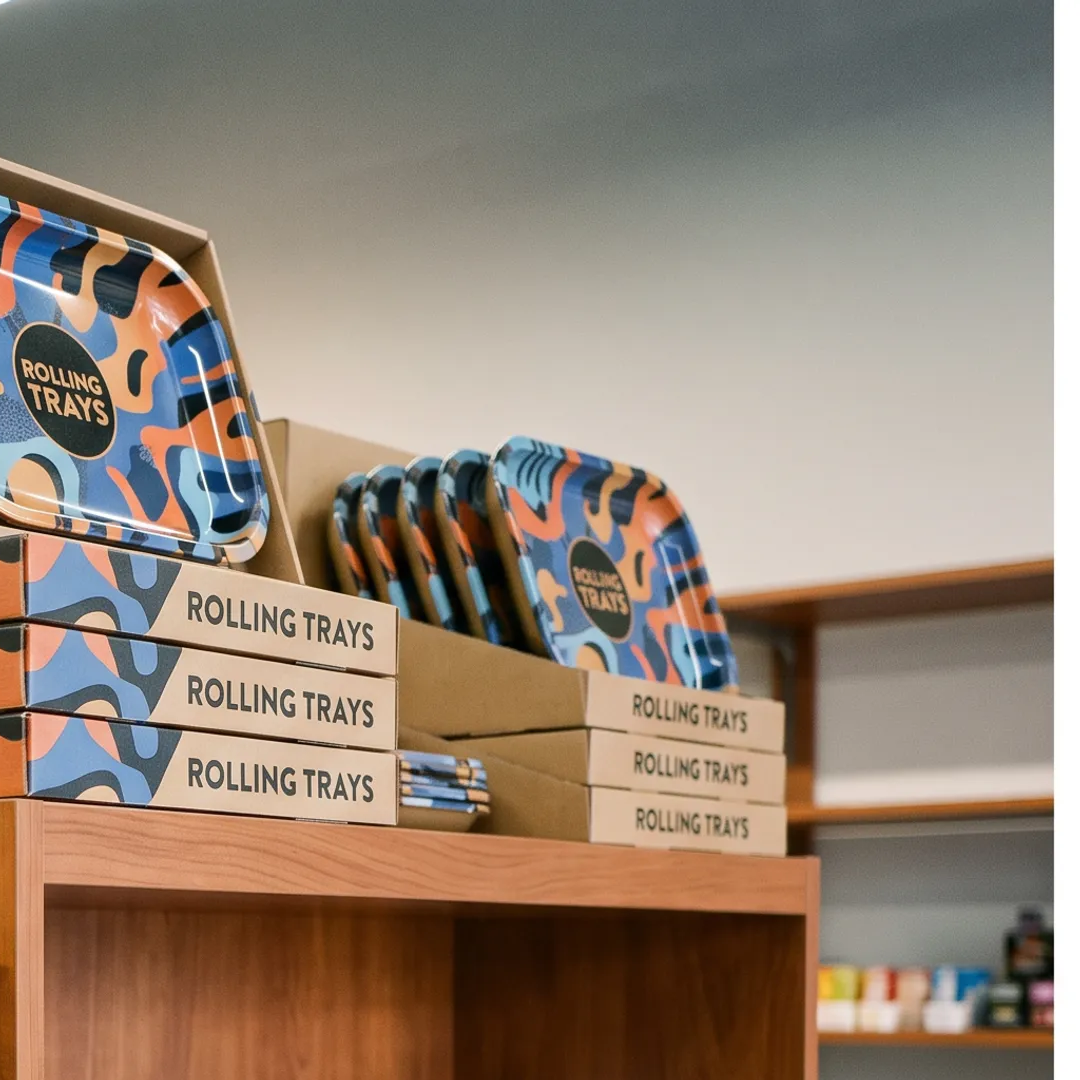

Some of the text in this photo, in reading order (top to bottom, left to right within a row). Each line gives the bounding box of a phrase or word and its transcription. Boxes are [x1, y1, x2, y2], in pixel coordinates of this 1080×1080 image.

[21, 358, 103, 396] ROLLING
[27, 383, 109, 427] TRAYS
[573, 565, 622, 590] ROLLING
[578, 586, 628, 615] TRAYS
[187, 590, 375, 651] ROLLING TRAYS
[187, 675, 375, 728] ROLLING TRAYS
[633, 694, 748, 734] ROLLING TRAYS
[188, 757, 375, 803] ROLLING TRAYS
[634, 751, 749, 786] ROLLING TRAYS
[635, 808, 749, 839] ROLLING TRAYS
